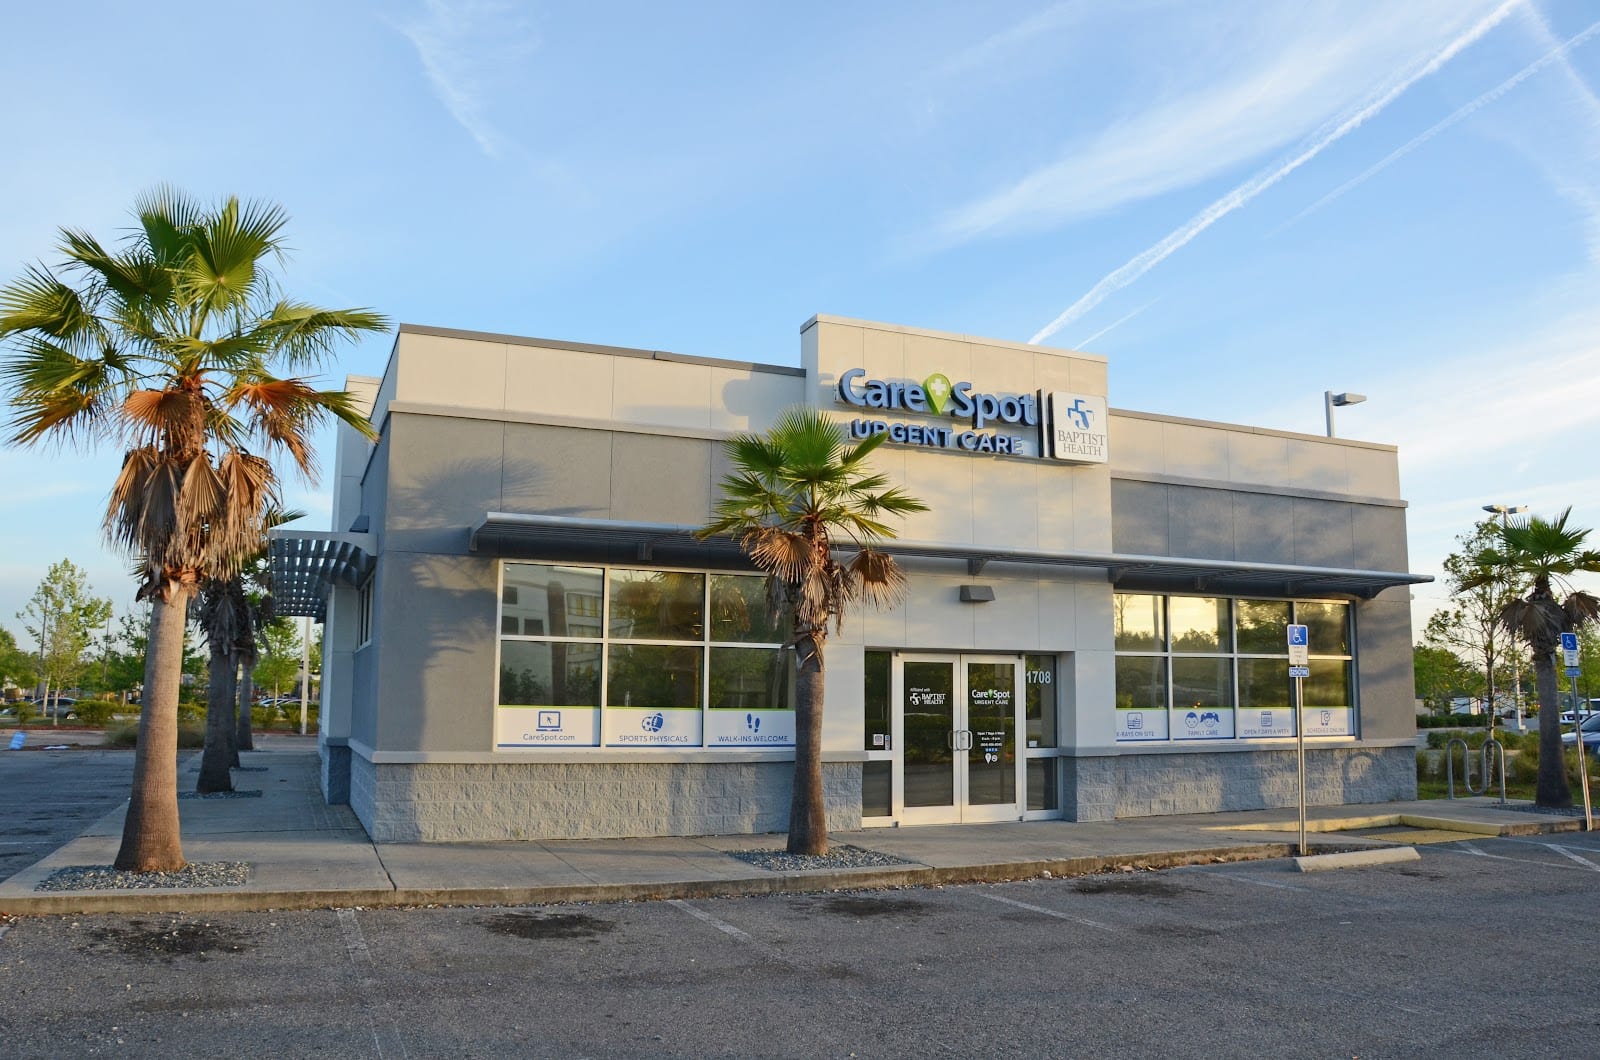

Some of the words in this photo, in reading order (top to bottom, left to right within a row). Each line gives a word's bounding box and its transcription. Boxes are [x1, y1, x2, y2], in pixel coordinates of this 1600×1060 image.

[839, 367, 926, 412] Care
[951, 381, 1037, 430] Spot
[956, 432, 1024, 455] CARE
[1057, 430, 1106, 447] BAPTIST
[1063, 443, 1102, 457] HEALTH
[1026, 671, 1051, 684] 1708
[971, 689, 989, 699] Care
[993, 689, 1010, 700] Spot
[523, 733, 576, 743] CareSpot.com
[619, 735, 648, 743] SPORTS
[649, 735, 688, 743] PHYSICALS
[718, 735, 752, 743] WALK-INS
[753, 735, 788, 743] WELCOME
